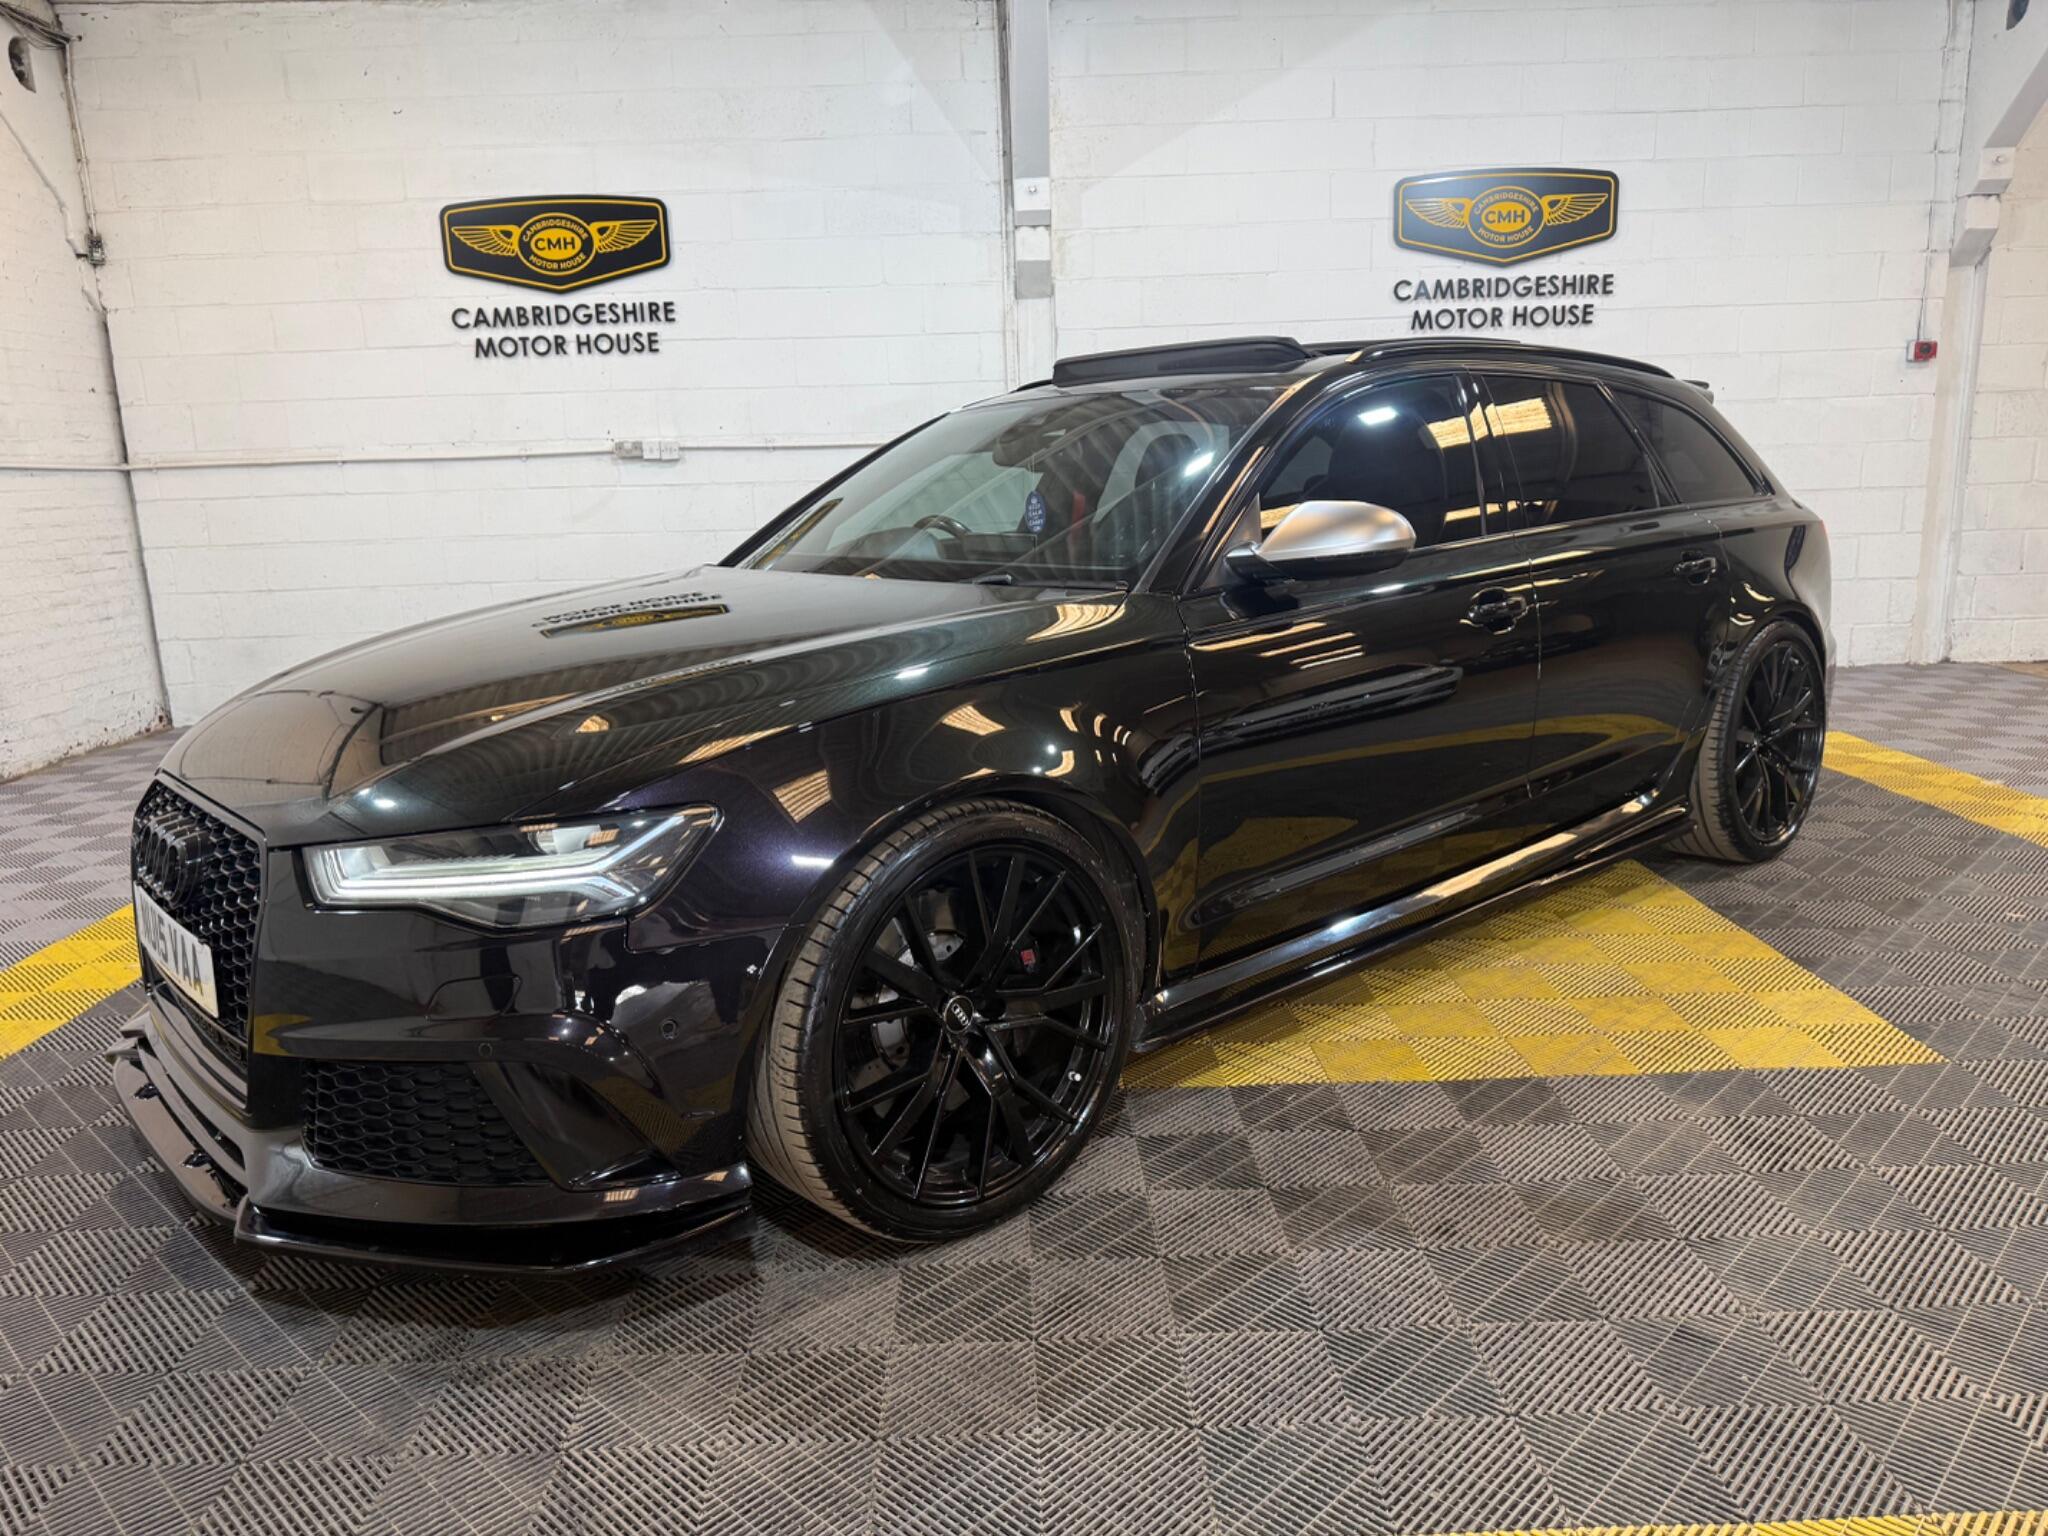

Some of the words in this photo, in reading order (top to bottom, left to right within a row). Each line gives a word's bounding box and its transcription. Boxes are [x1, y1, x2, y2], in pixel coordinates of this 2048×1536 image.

[1485, 209, 1525, 224] CMH
[523, 219, 589, 242] CAMBRIDGESHIRE
[534, 236, 576, 251] CMH
[529, 255, 559, 270] MOTOR
[560, 252, 586, 270] HOUSE
[1393, 273, 1614, 302] CAMBRIDGESHIRE
[451, 301, 676, 329] CAMBRIDGESHIRE
[1411, 308, 1504, 330] MOTOR
[1512, 304, 1594, 327] HOUSE
[475, 335, 567, 358] MOTOR
[576, 332, 660, 355] HOUSE
[168, 923, 204, 996] VAA
